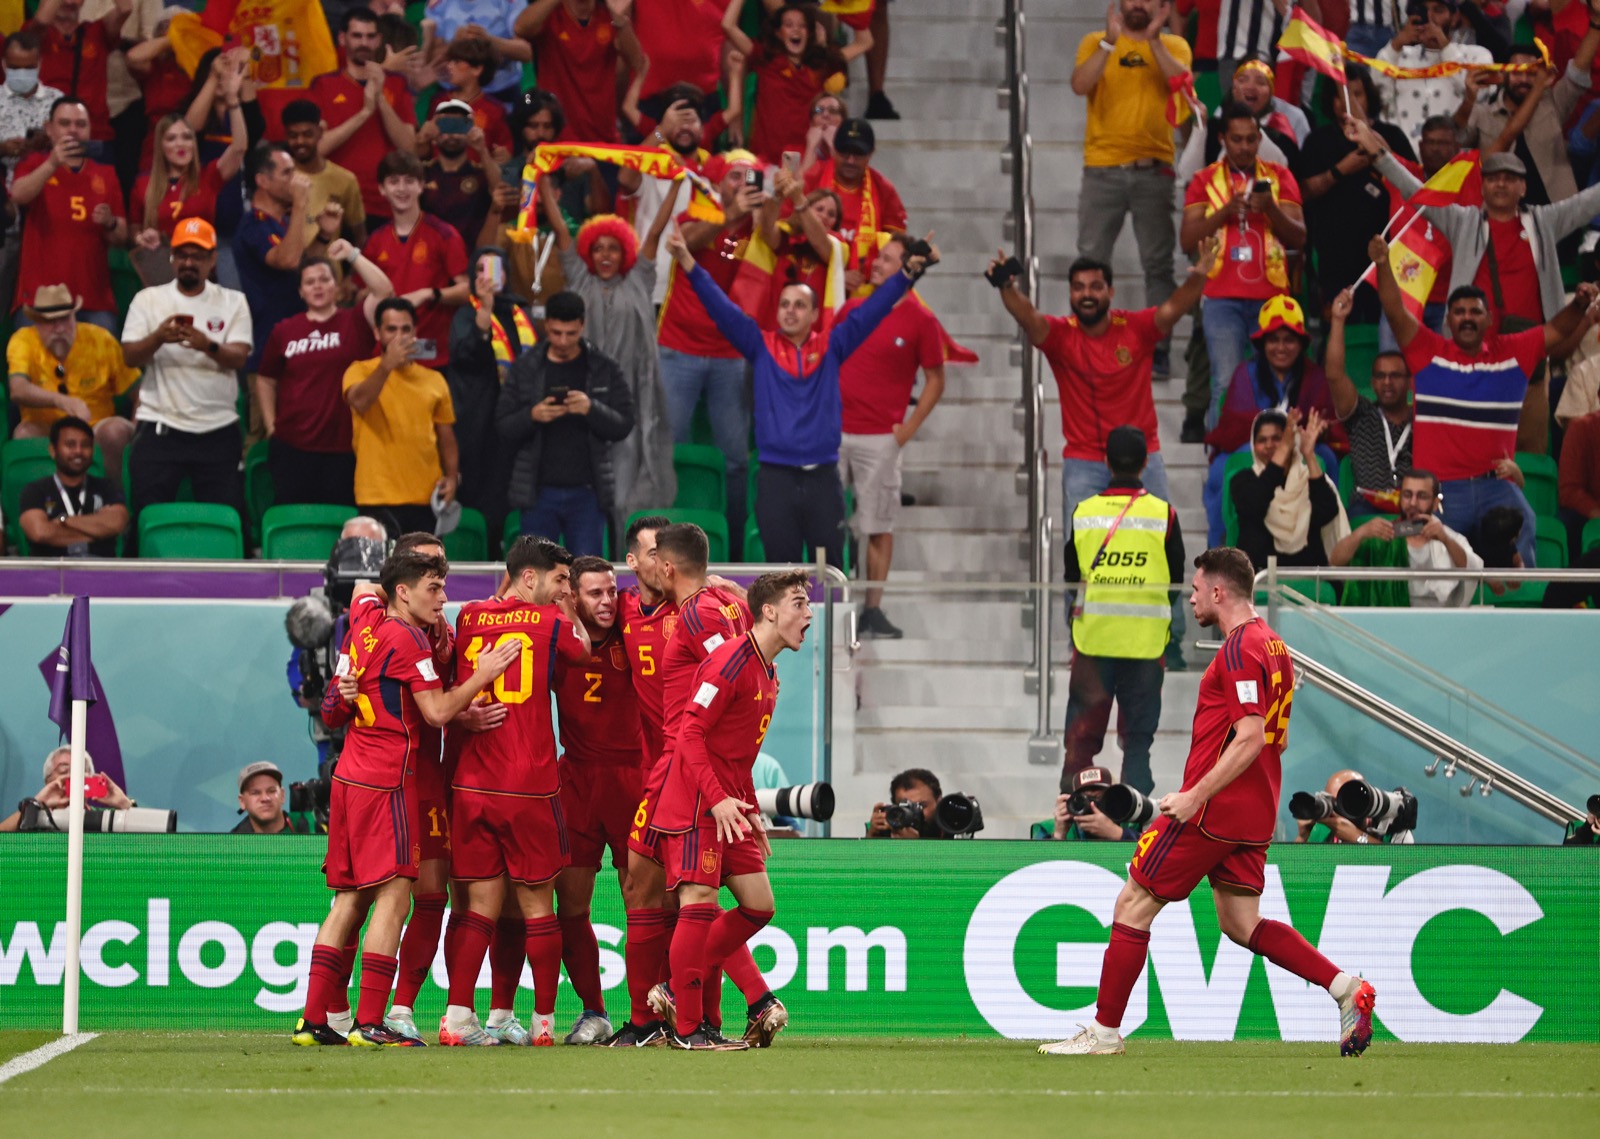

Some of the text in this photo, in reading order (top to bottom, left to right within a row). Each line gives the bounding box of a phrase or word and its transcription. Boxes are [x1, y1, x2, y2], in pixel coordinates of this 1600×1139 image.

[70, 196, 87, 221] 5
[169, 201, 183, 219] 7
[1096, 551, 1148, 567] 2055
[1092, 573, 1146, 588] Security
[461, 610, 541, 627] M. ASENSIO
[464, 632, 533, 704] 10
[638, 645, 656, 676] 5
[583, 672, 602, 702] 2
[755, 713, 771, 745] 9
[964, 860, 1543, 1043] GWC
